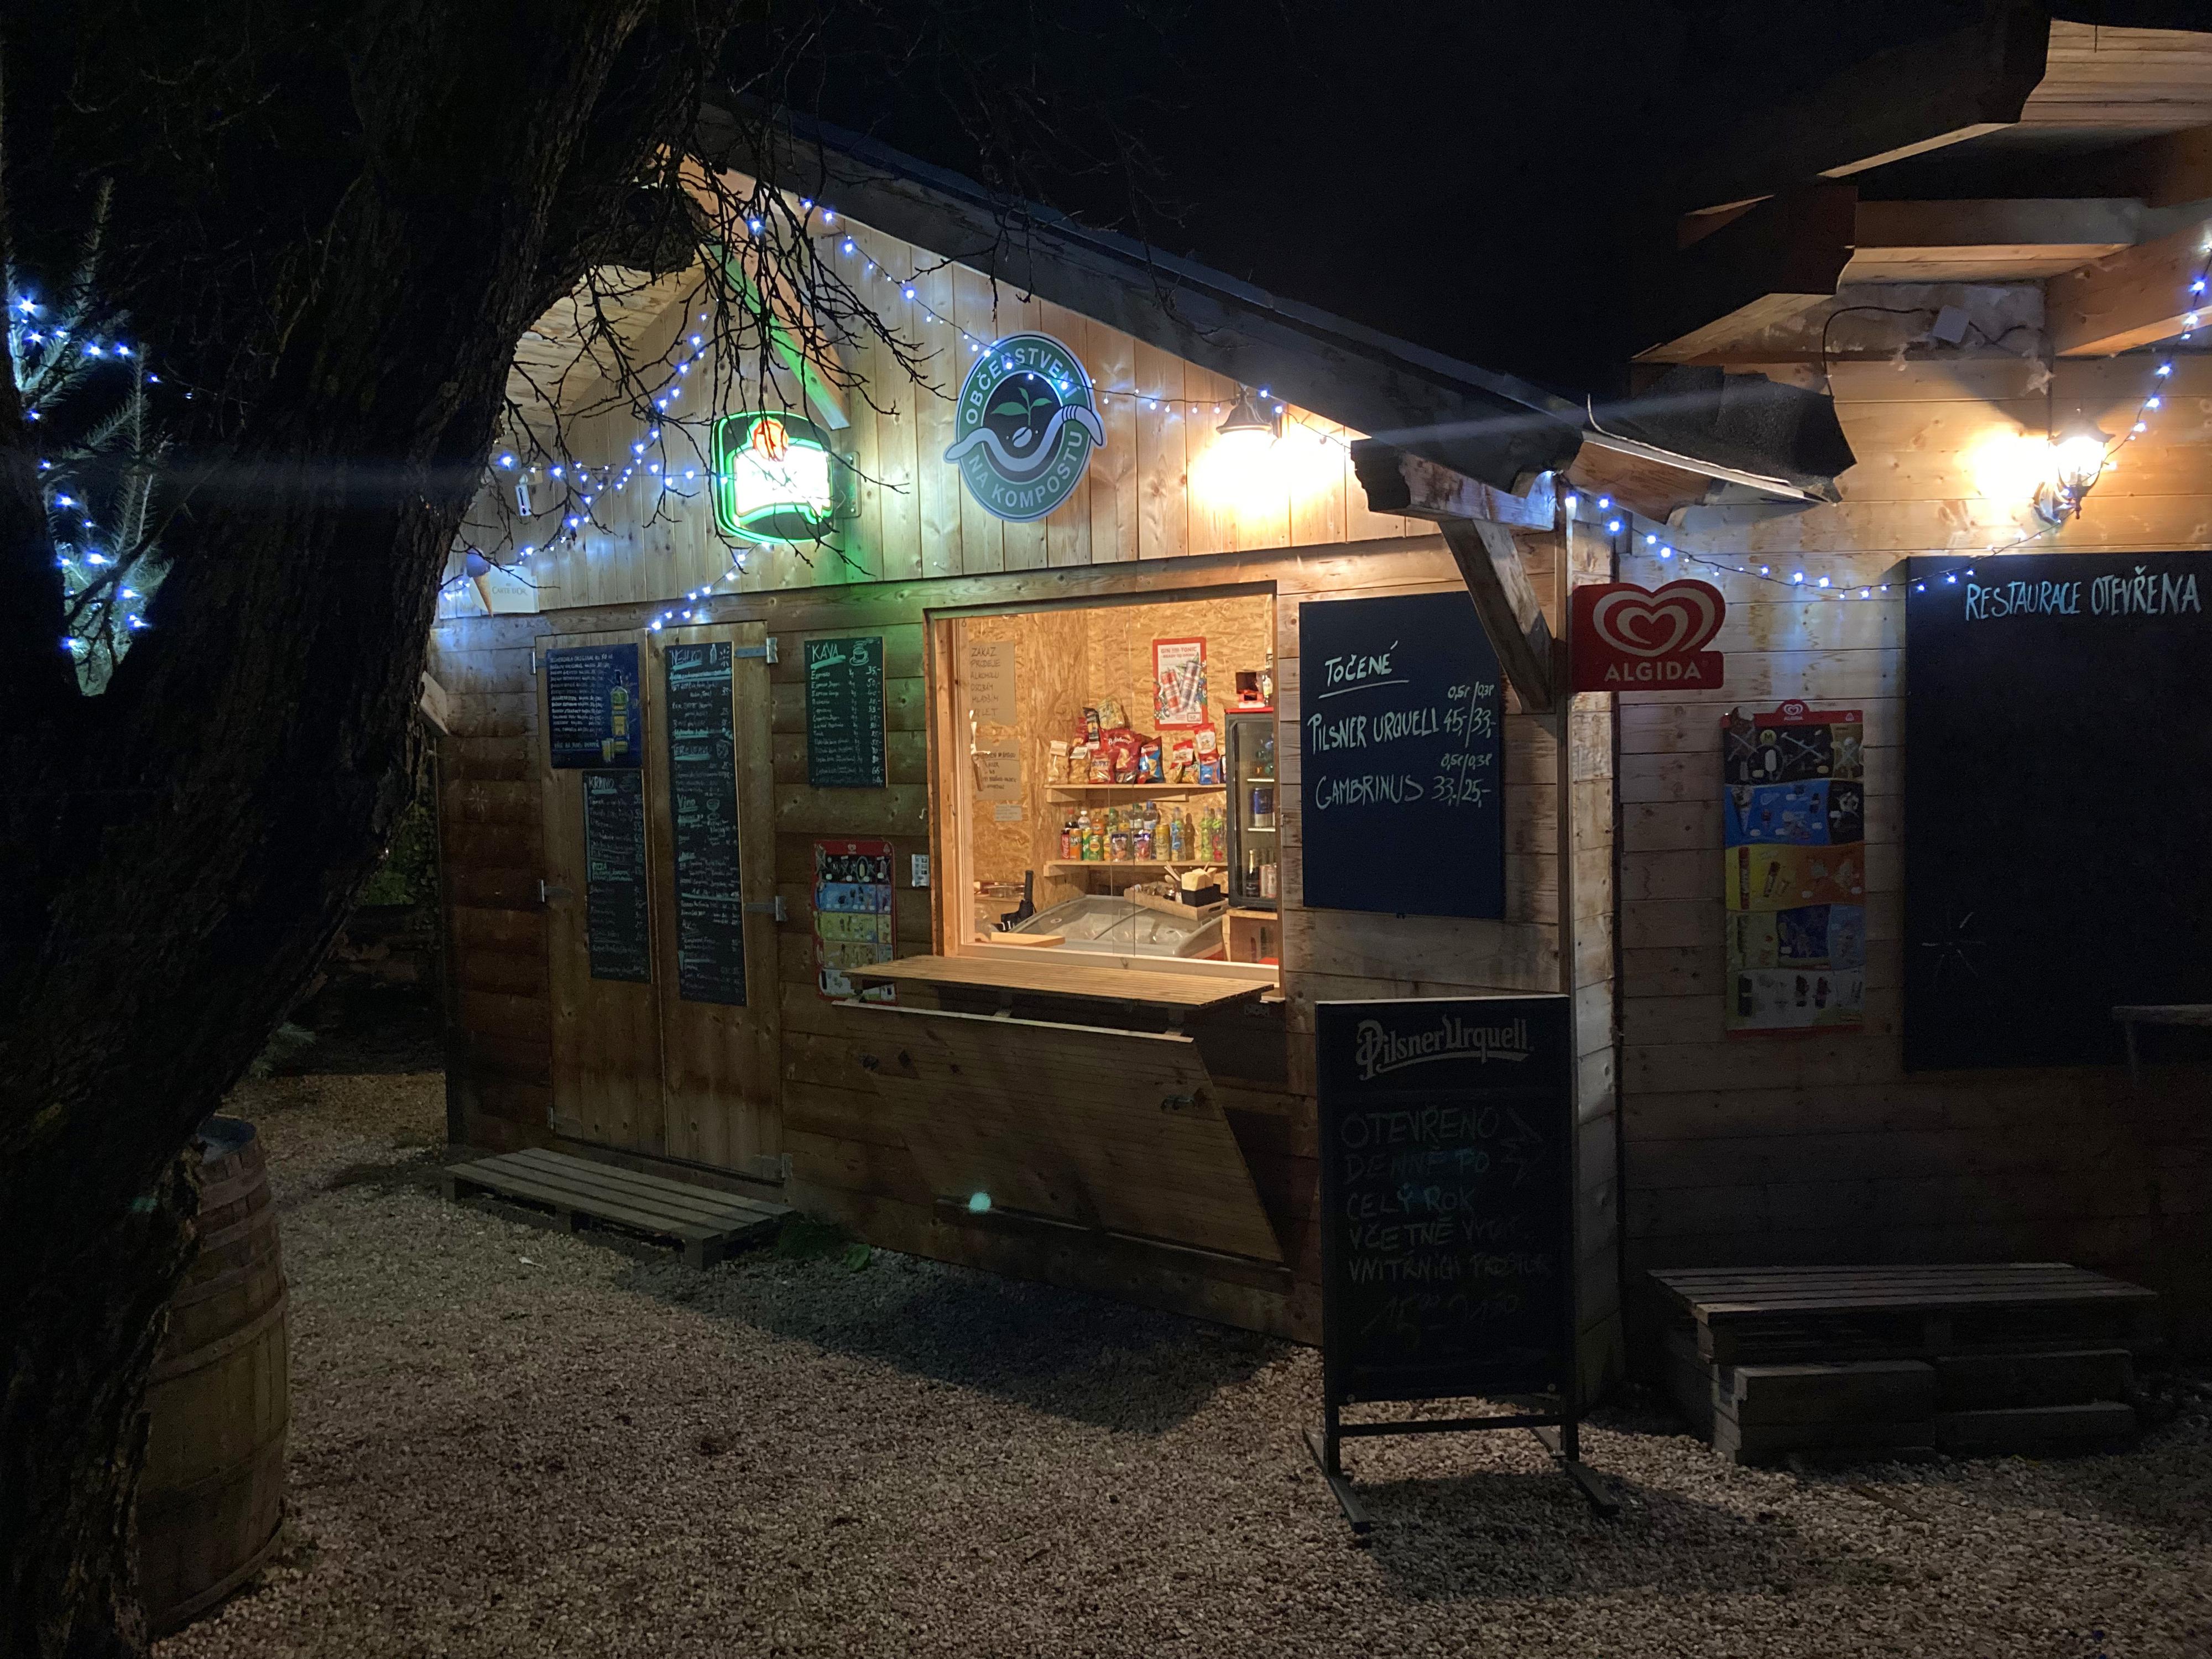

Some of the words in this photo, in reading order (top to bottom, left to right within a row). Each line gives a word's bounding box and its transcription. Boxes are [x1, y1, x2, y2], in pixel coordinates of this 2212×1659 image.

[968, 455, 989, 489] NA
[992, 430, 1084, 509] KOMPOSTU
[1965, 581, 2083, 622] RESTAURACE
[2091, 565, 2202, 616] OTEVŘENA
[1324, 640, 1399, 686] TOČENÉ
[1604, 660, 1702, 682] ALGIDA
[1307, 713, 1368, 755] PILSNER
[1373, 707, 1441, 743] URQUELL
[1315, 774, 1425, 810] GAMBRINUS
[1355, 1019, 1445, 1081] Pilsner
[1442, 1014, 1528, 1065] Urquell
[1423, 1185, 1477, 1218] ROK
